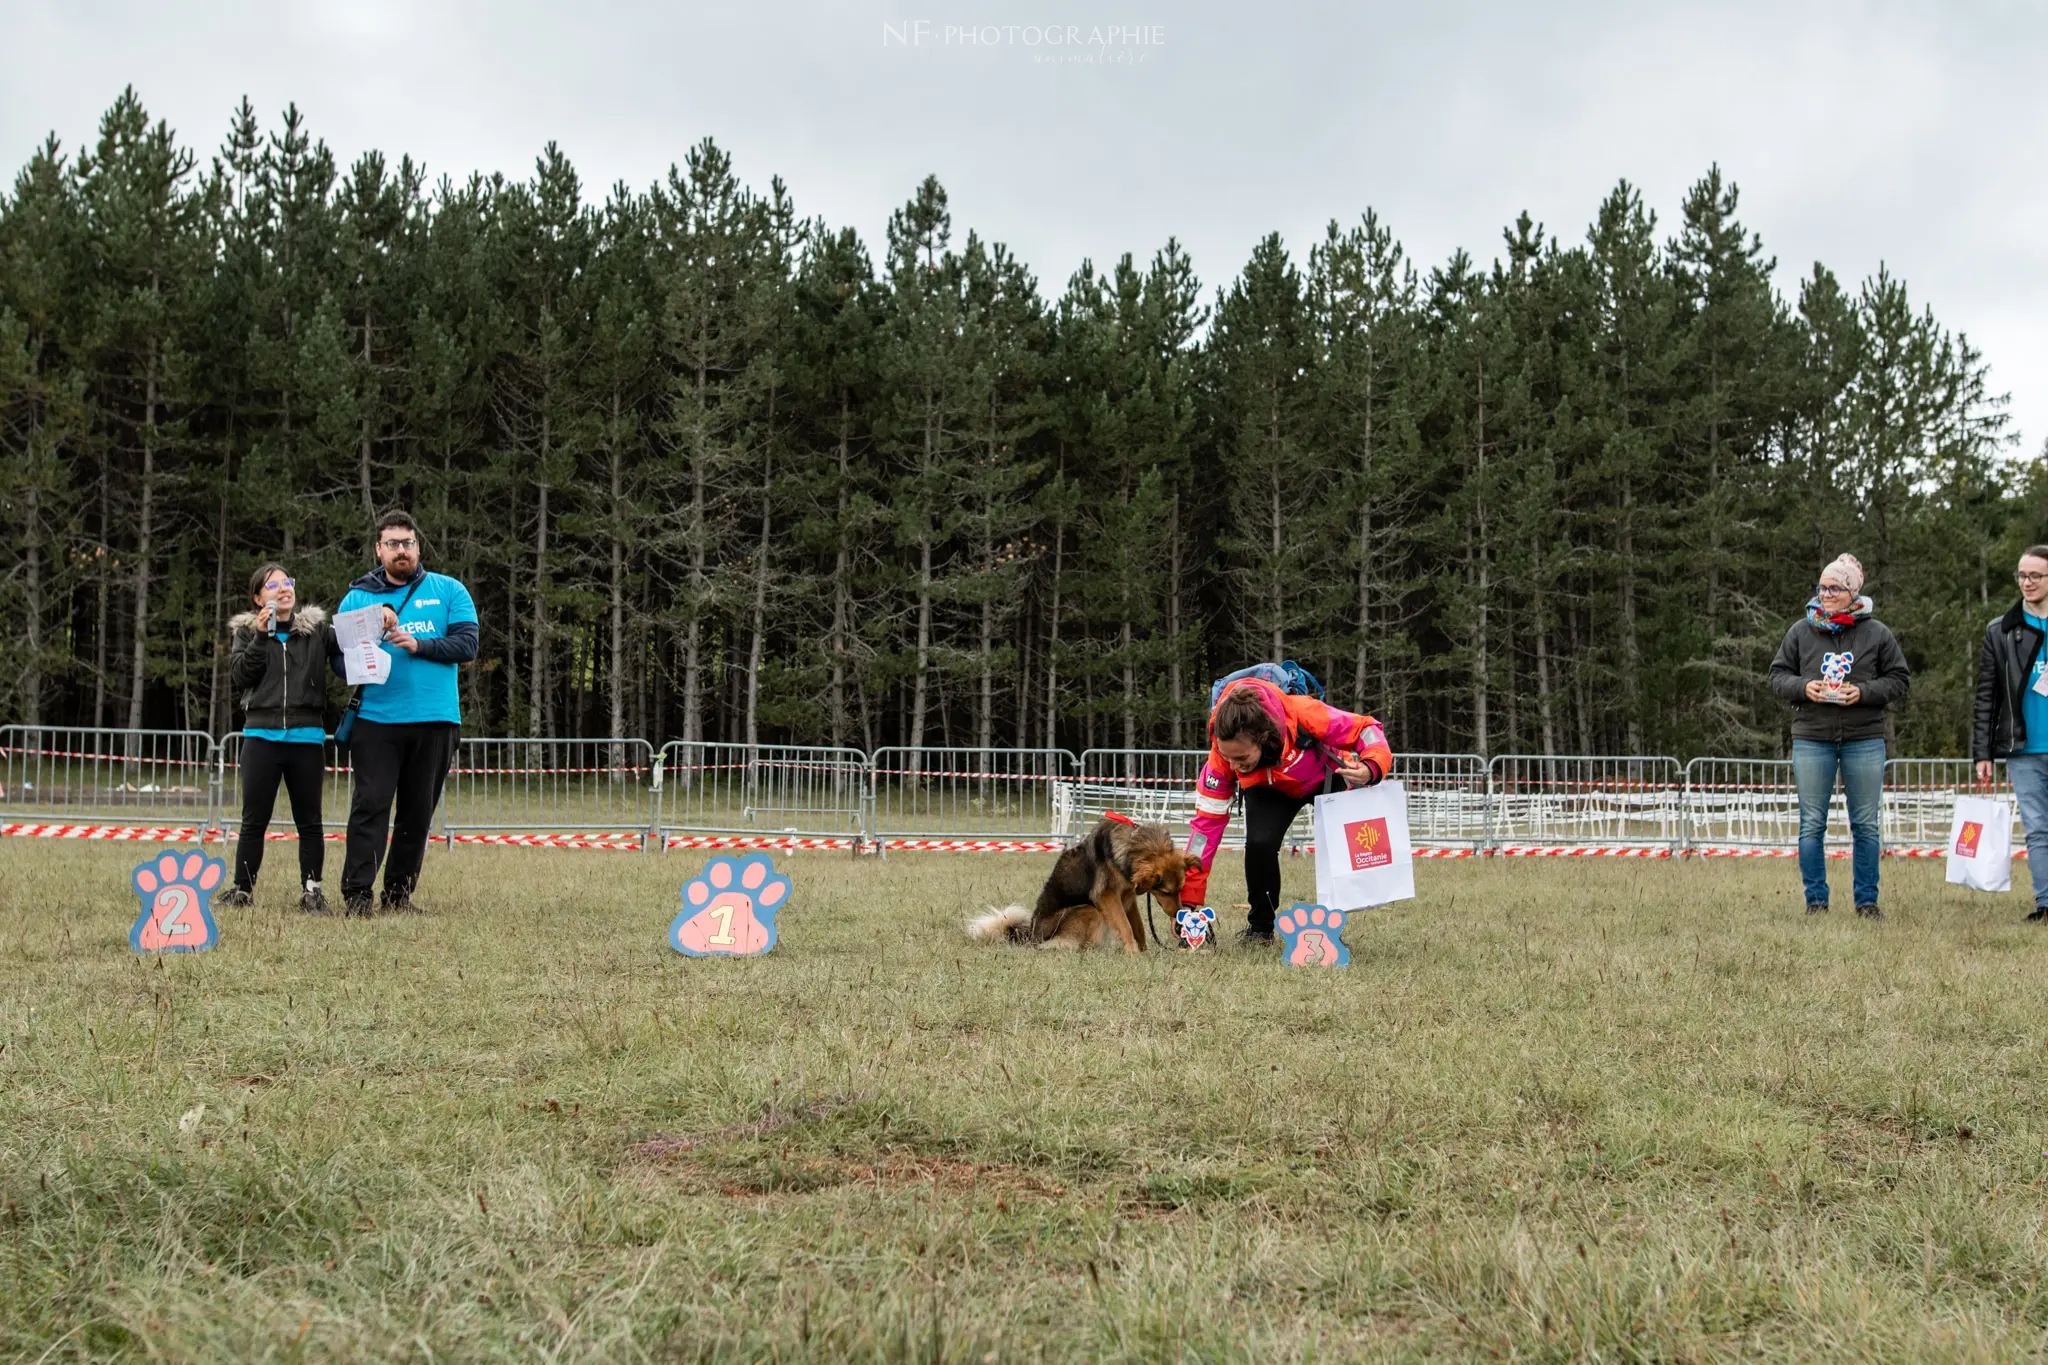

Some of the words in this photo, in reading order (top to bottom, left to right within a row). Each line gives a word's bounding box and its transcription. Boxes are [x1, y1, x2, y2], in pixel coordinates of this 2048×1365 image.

[1206, 775, 1220, 787] HH
[1355, 852, 1388, 865] Occitanie
[159, 888, 192, 936] 2
[708, 904, 737, 945] 1
[1303, 933, 1326, 965] 3
